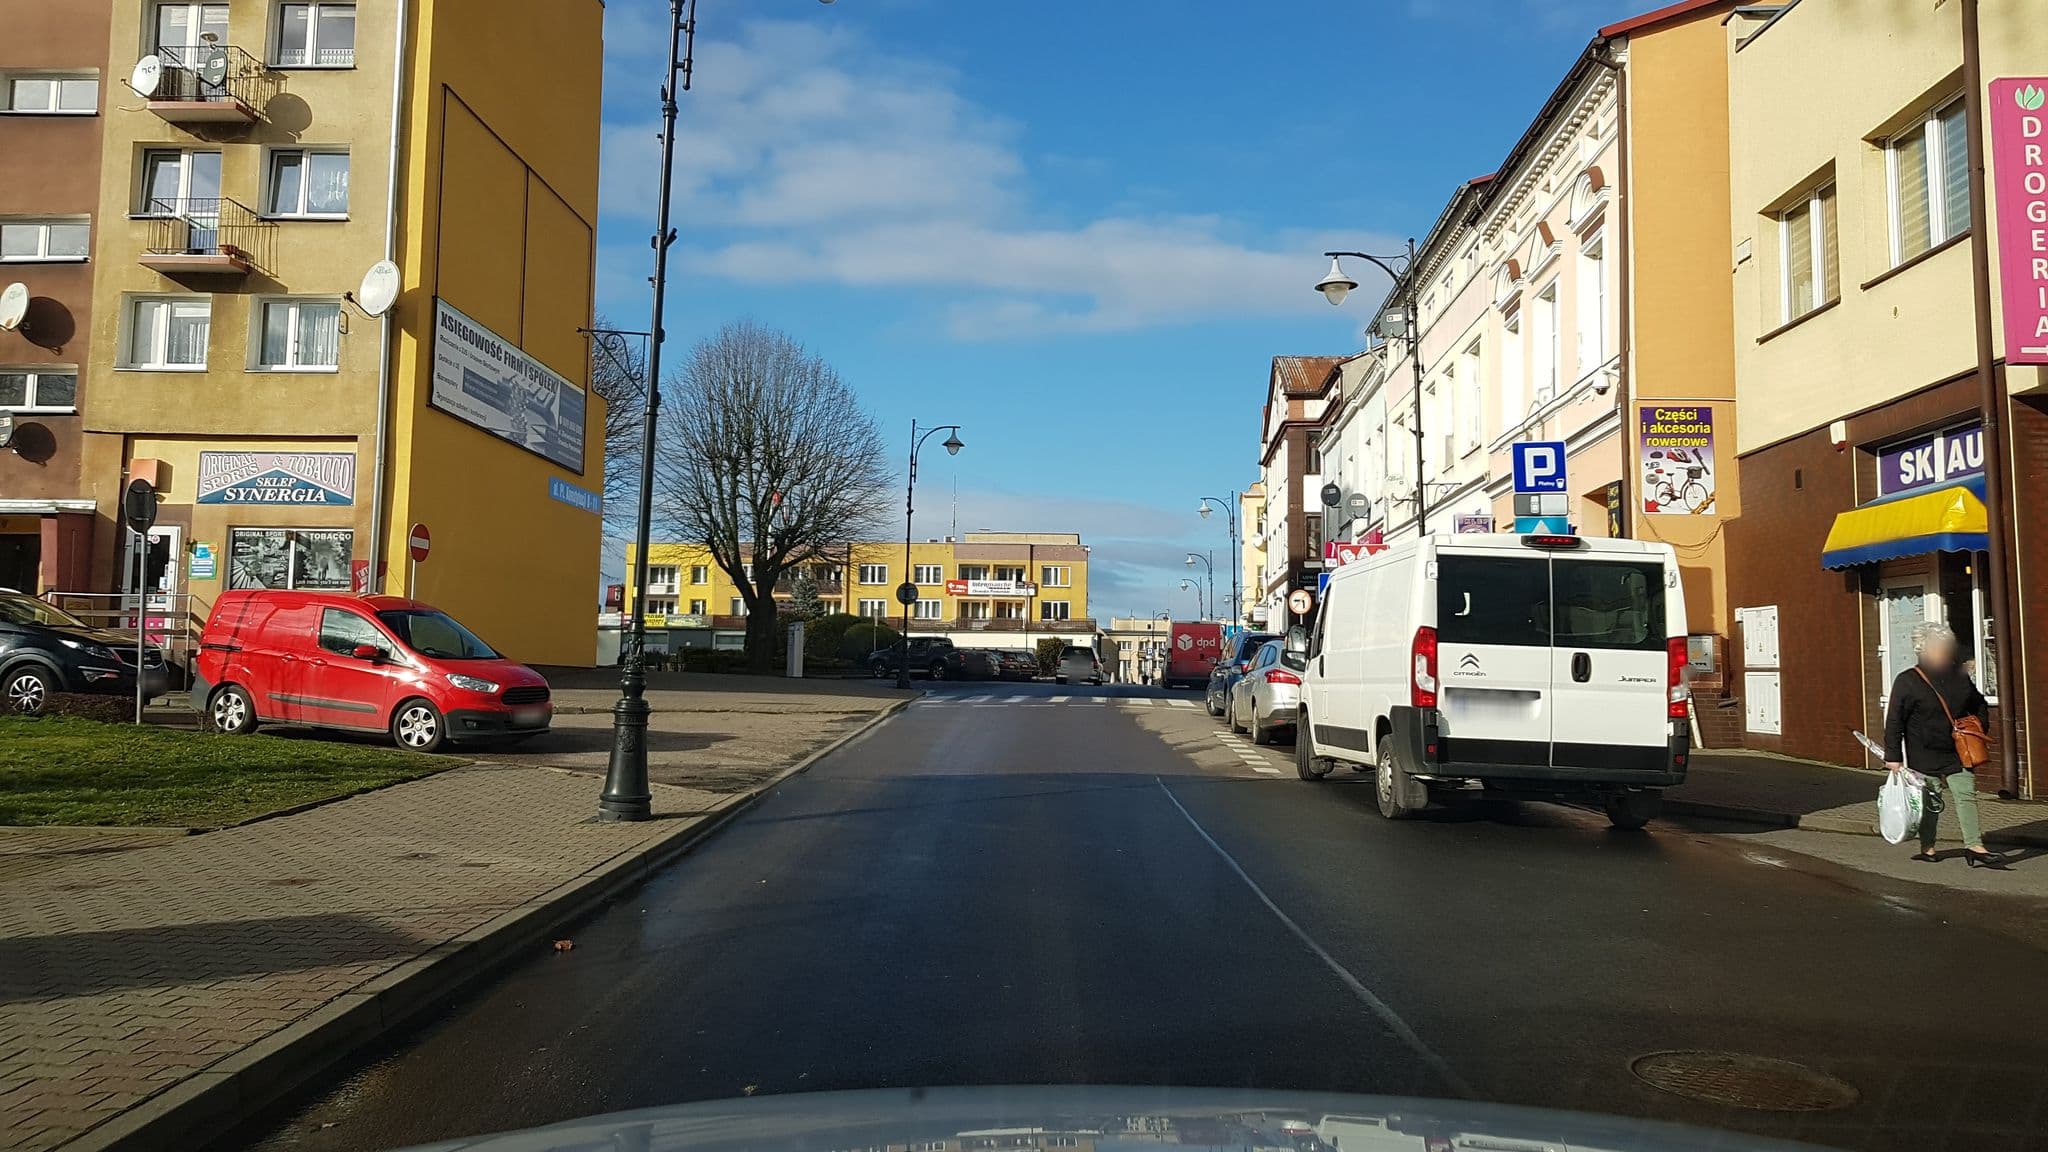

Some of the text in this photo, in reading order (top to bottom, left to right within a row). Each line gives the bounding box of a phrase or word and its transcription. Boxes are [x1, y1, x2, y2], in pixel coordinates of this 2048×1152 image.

[2021, 115, 2048, 339] DROGERIA
[440, 311, 503, 362] KSIĘGOWOŚĆ
[503, 350, 523, 375] FIRM
[1655, 408, 1698, 423] Części
[1642, 422, 1711, 433] i akcesoria
[1646, 437, 1708, 447] rowerowe
[202, 454, 257, 478] ORIGINAL
[272, 455, 351, 492] & TOBACCO
[1524, 447, 1556, 487] P
[202, 463, 259, 492] SPORTS
[255, 477, 297, 488] SKLEP
[223, 487, 327, 502] SYNERGIA
[1196, 637, 1216, 648] dpd
